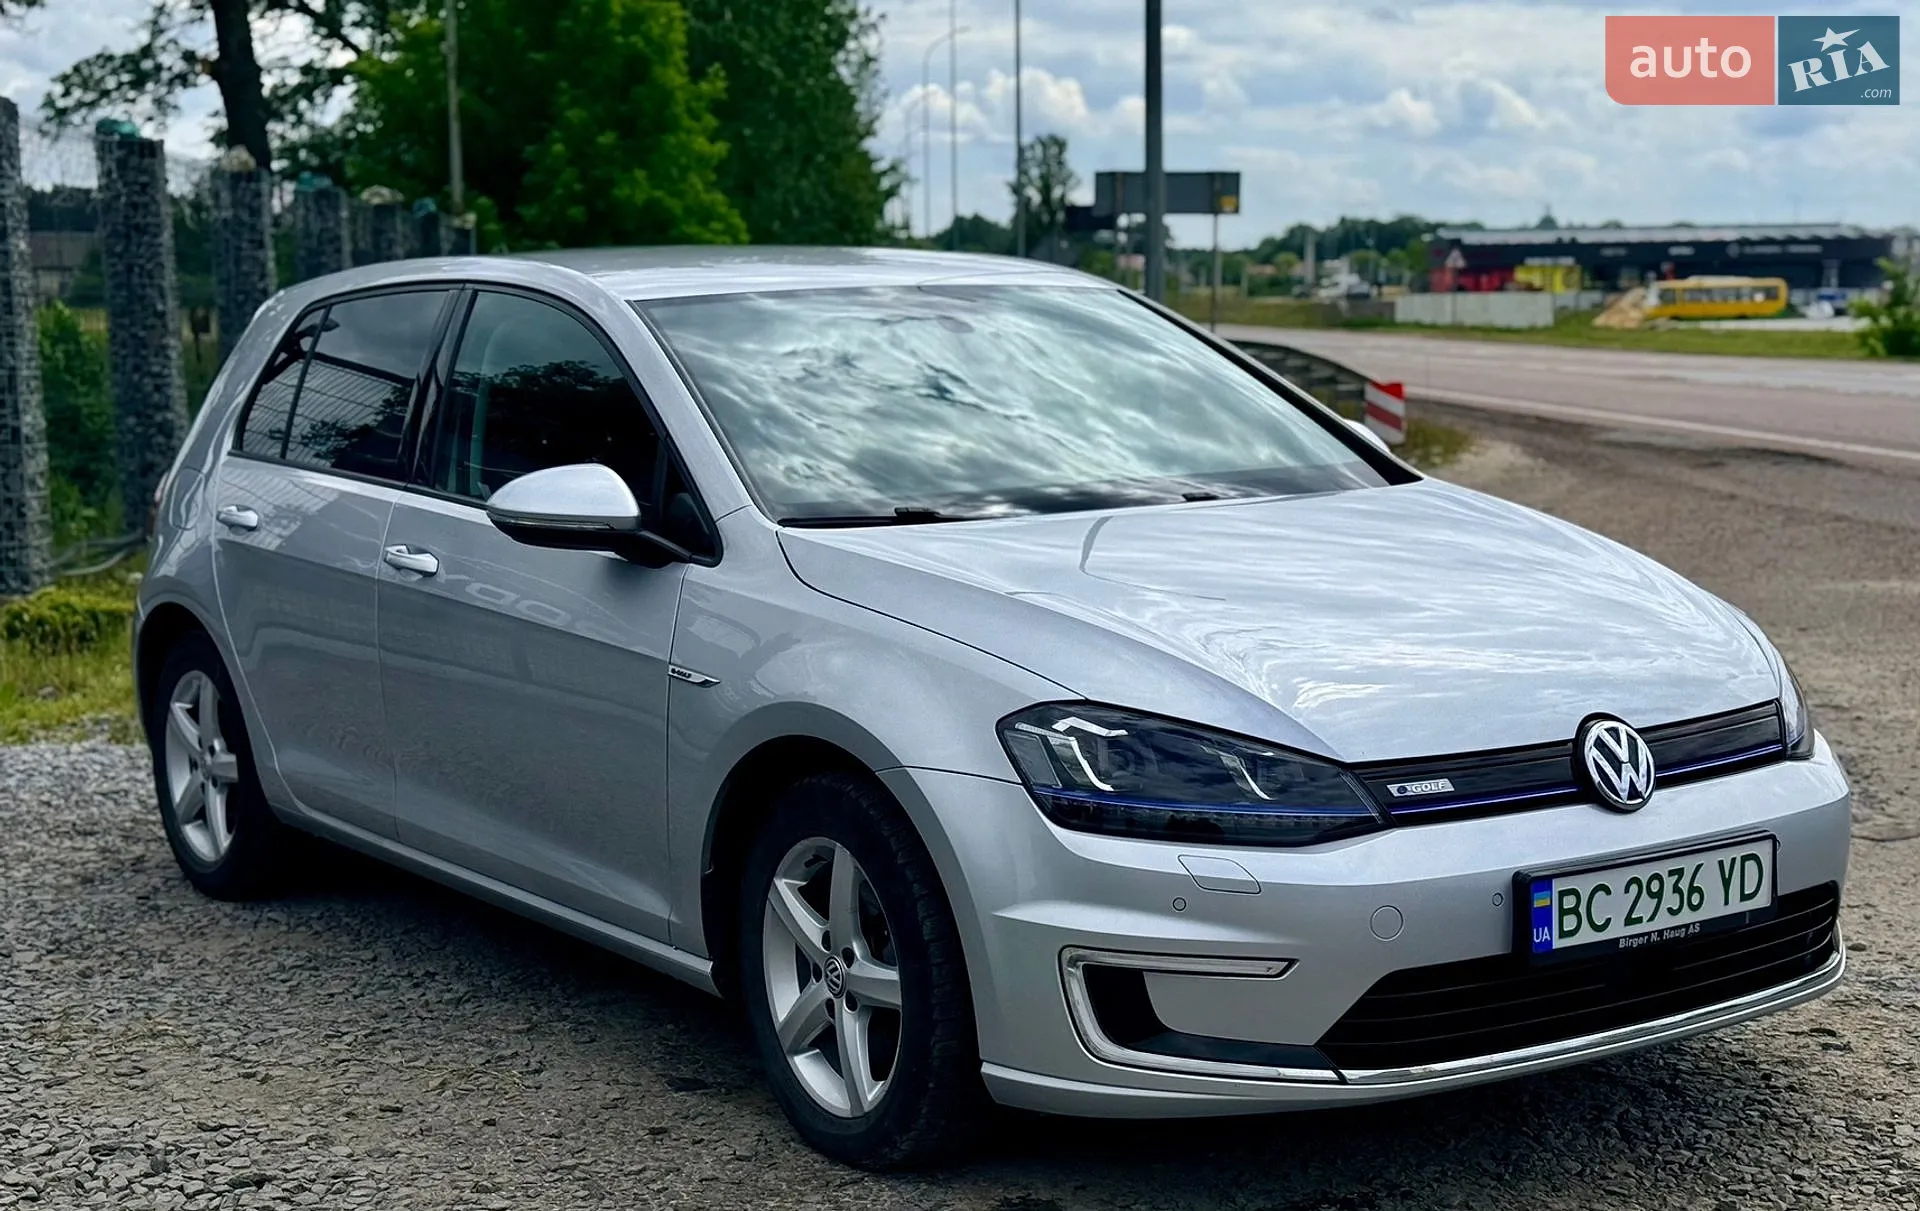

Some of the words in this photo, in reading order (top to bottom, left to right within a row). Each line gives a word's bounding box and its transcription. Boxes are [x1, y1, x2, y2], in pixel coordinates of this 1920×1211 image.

[1558, 883, 1612, 940] BC
[1624, 862, 1705, 927] 2936
[1718, 852, 1764, 906] YD
[1533, 926, 1551, 943] UA
[1619, 935, 1648, 948] Birger
[1650, 931, 1660, 943] N.
[1663, 928, 1686, 939] Haug
[1687, 923, 1700, 935] AS
